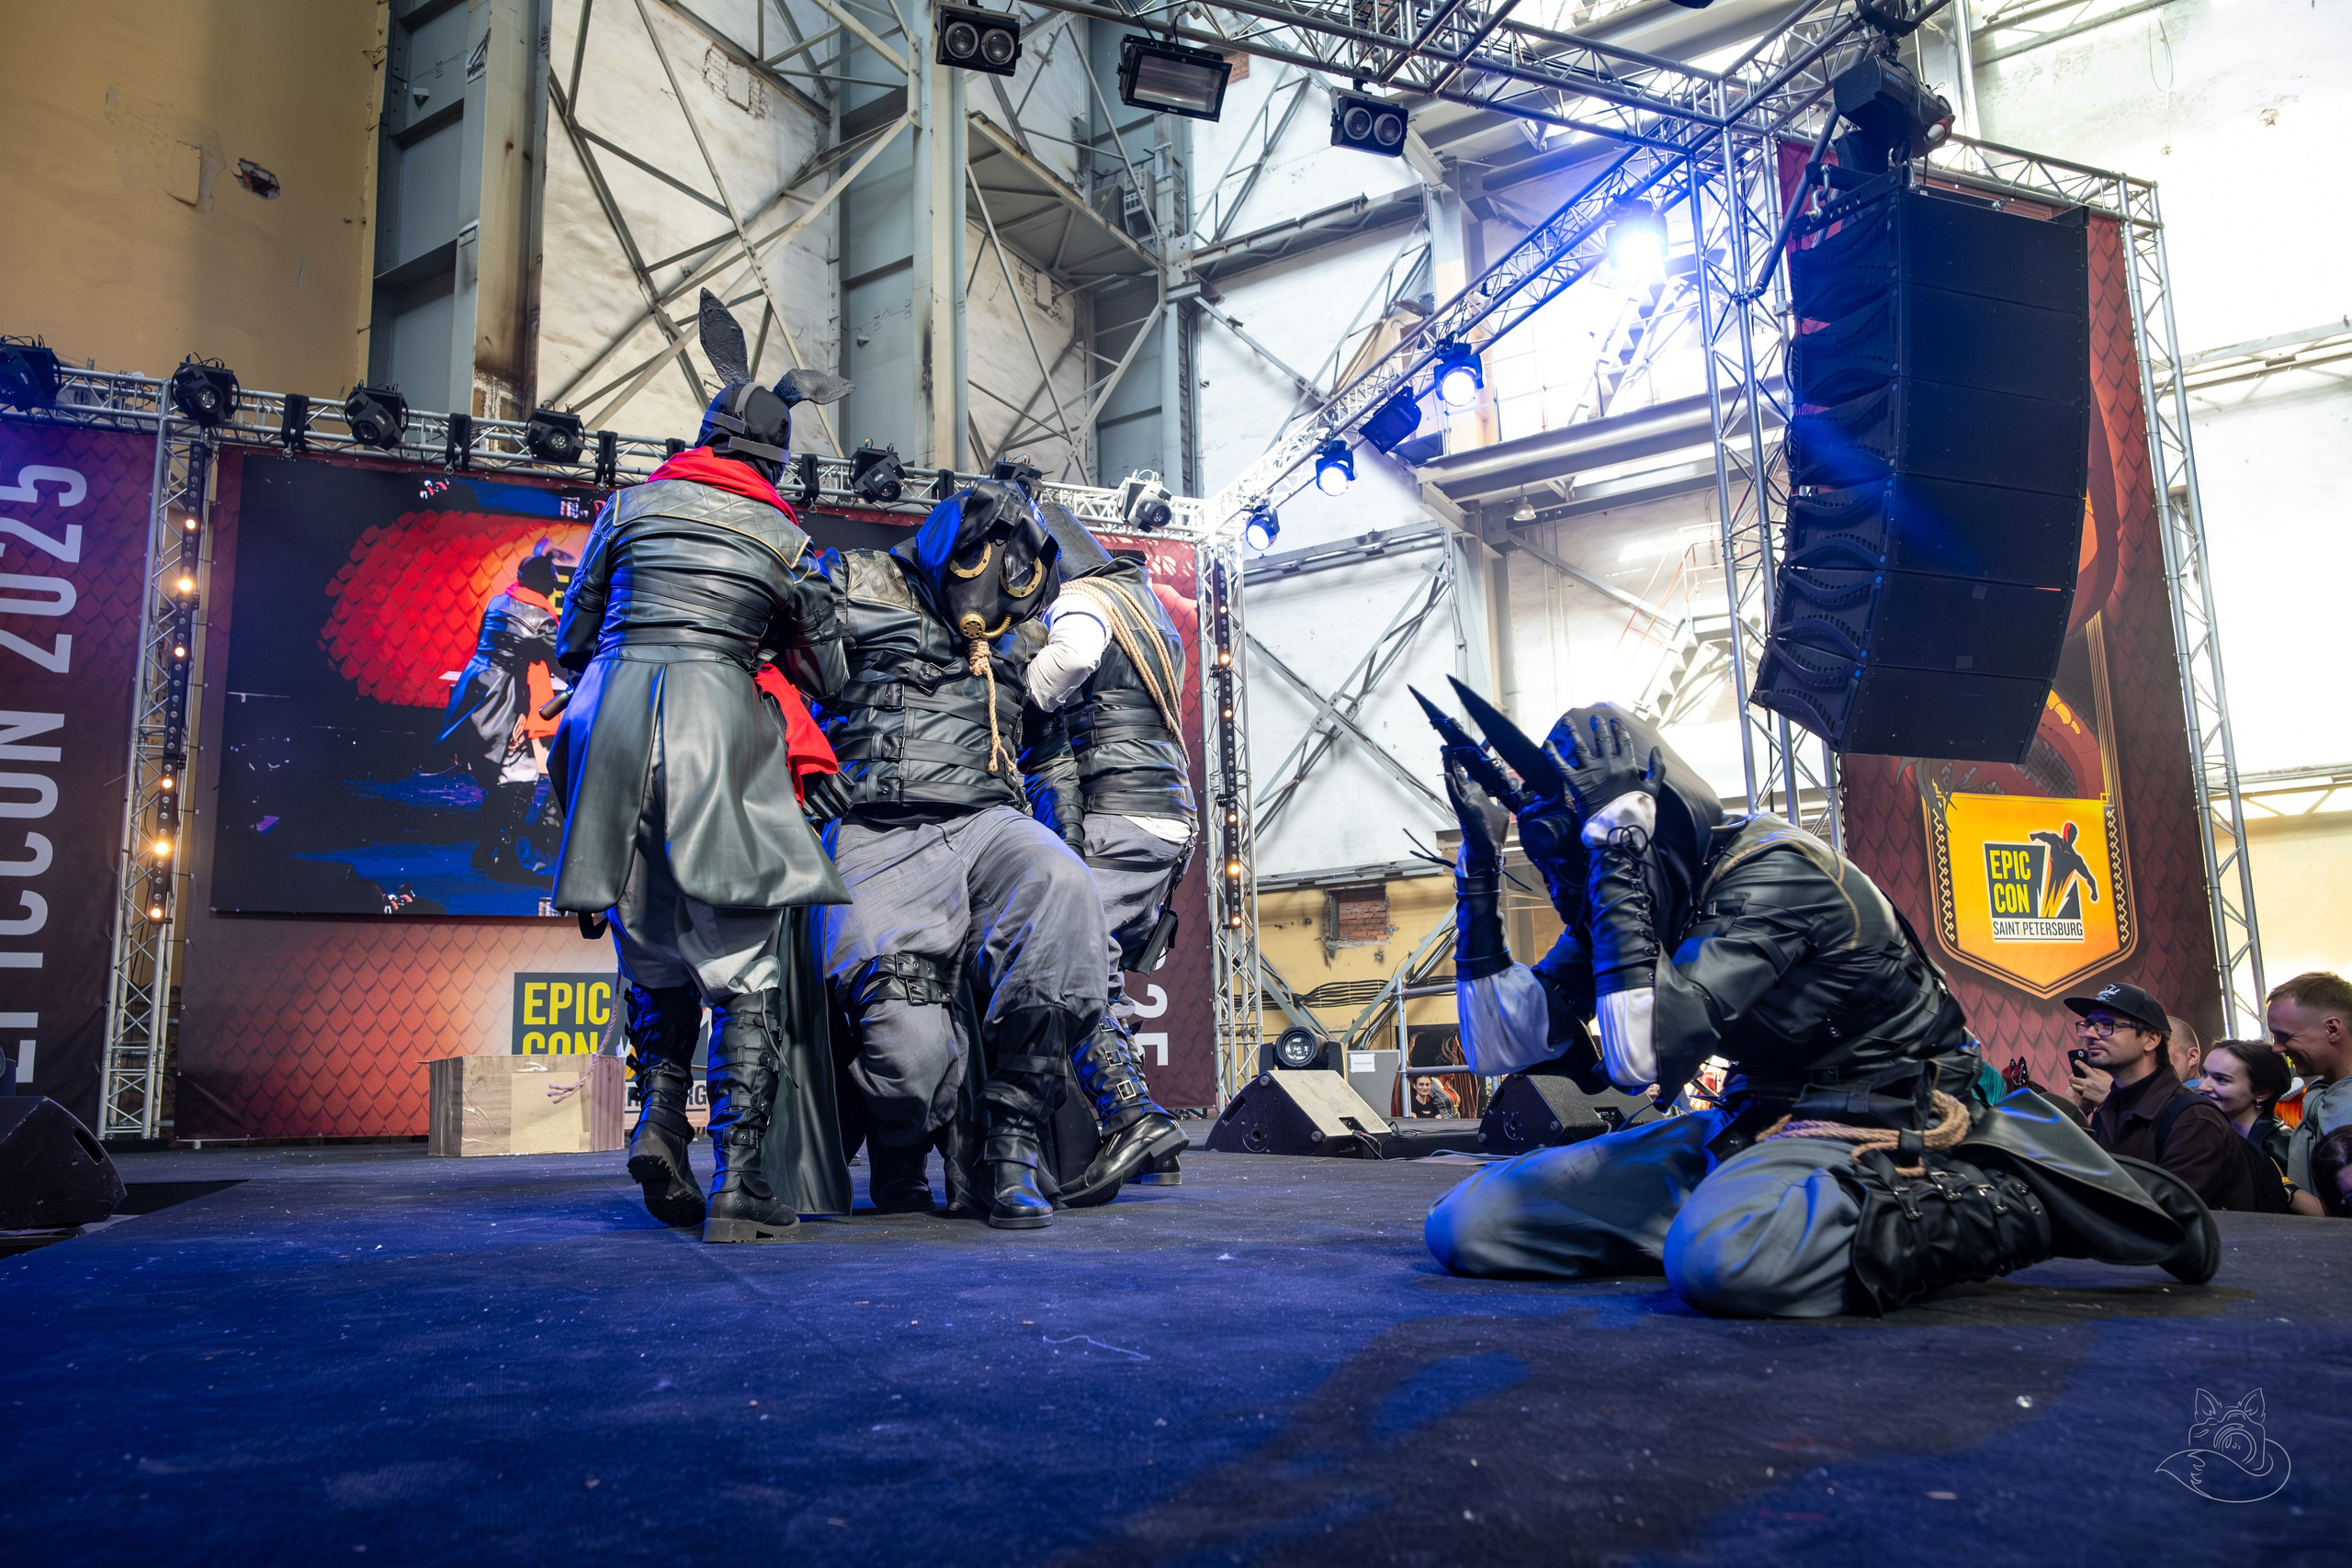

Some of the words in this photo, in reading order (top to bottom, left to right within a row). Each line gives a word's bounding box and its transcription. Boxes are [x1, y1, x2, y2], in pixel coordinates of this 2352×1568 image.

[0, 464, 87, 674] 2025
[1989, 850, 2031, 880] EPIC
[1993, 883, 2030, 913] CON
[1993, 921, 2020, 936] SAINT
[2022, 922, 2084, 936] PETERSBURG
[523, 981, 611, 1025] EPIC
